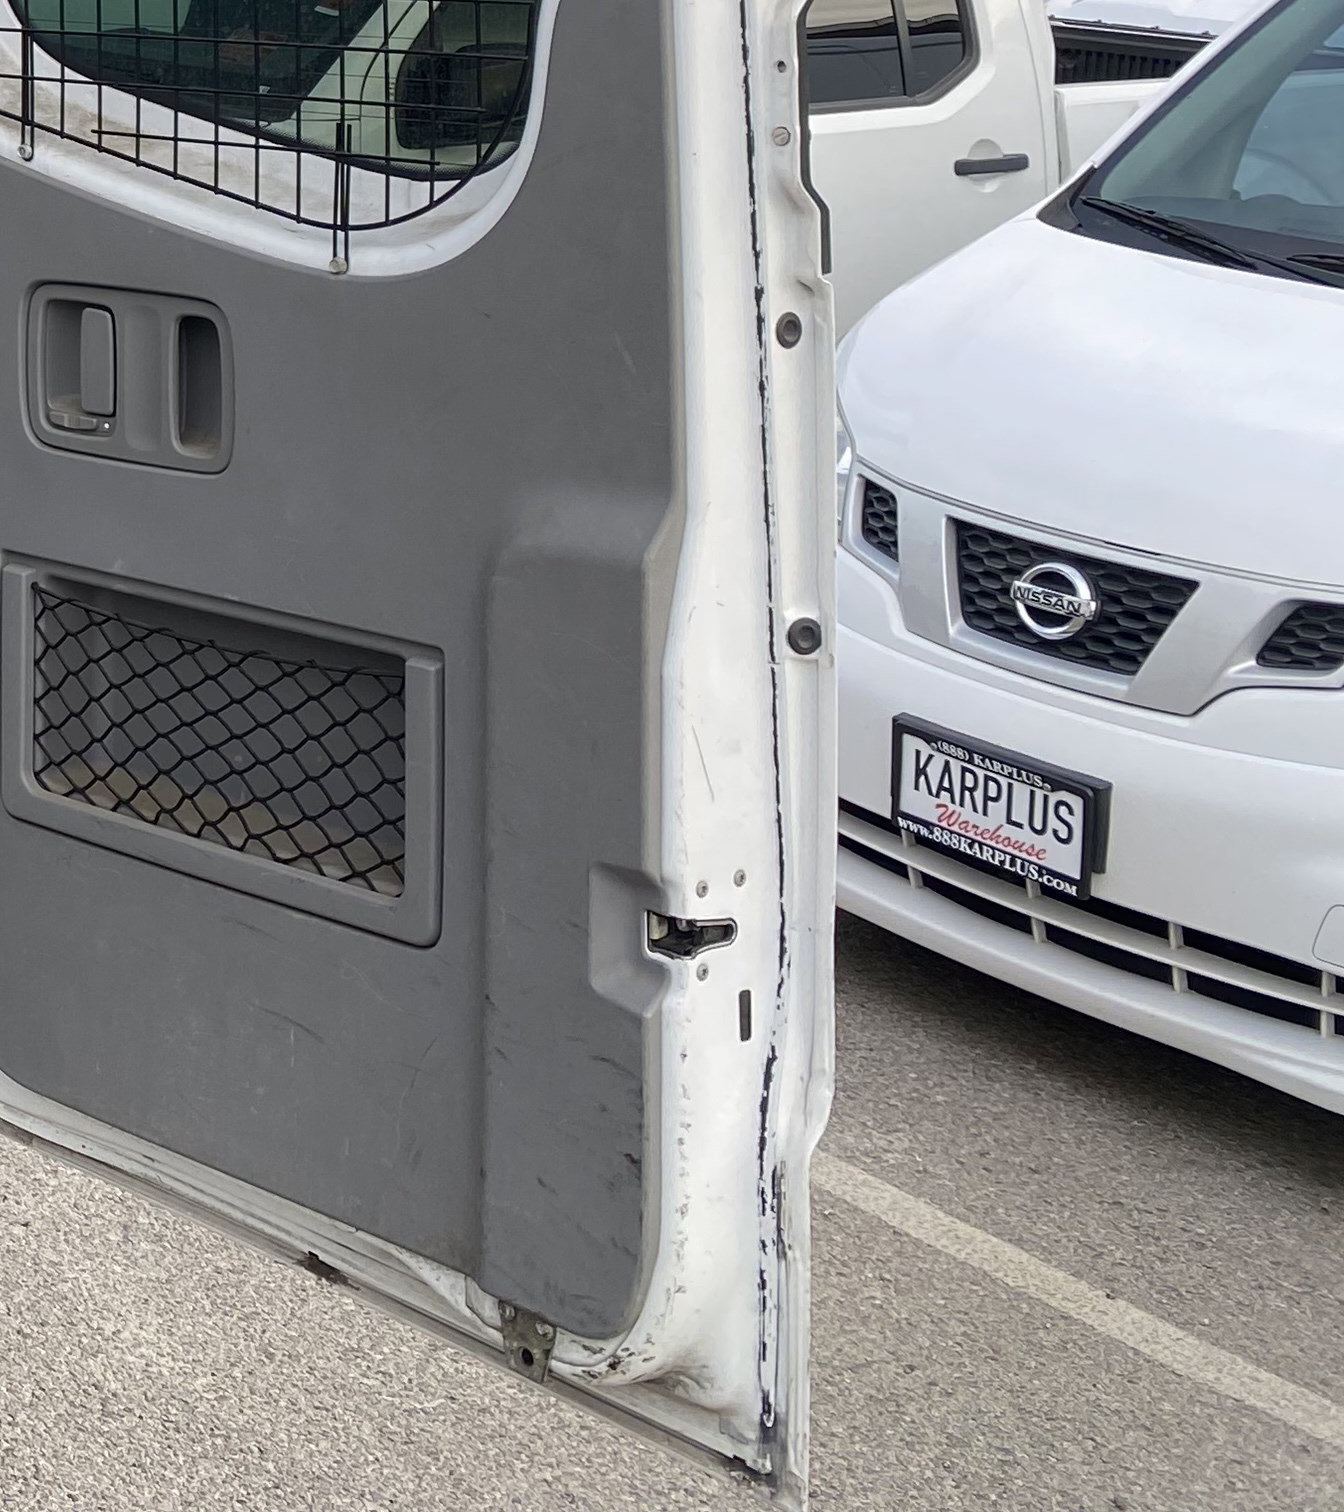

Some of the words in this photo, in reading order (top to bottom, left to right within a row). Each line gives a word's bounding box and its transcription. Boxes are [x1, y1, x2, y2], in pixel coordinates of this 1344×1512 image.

[1014, 585, 1081, 614] NISSAN
[938, 740, 969, 762] (888)
[973, 753, 1044, 788] KARPLUS
[914, 748, 1075, 846] KARPLUS
[935, 803, 1047, 861] Warehouse
